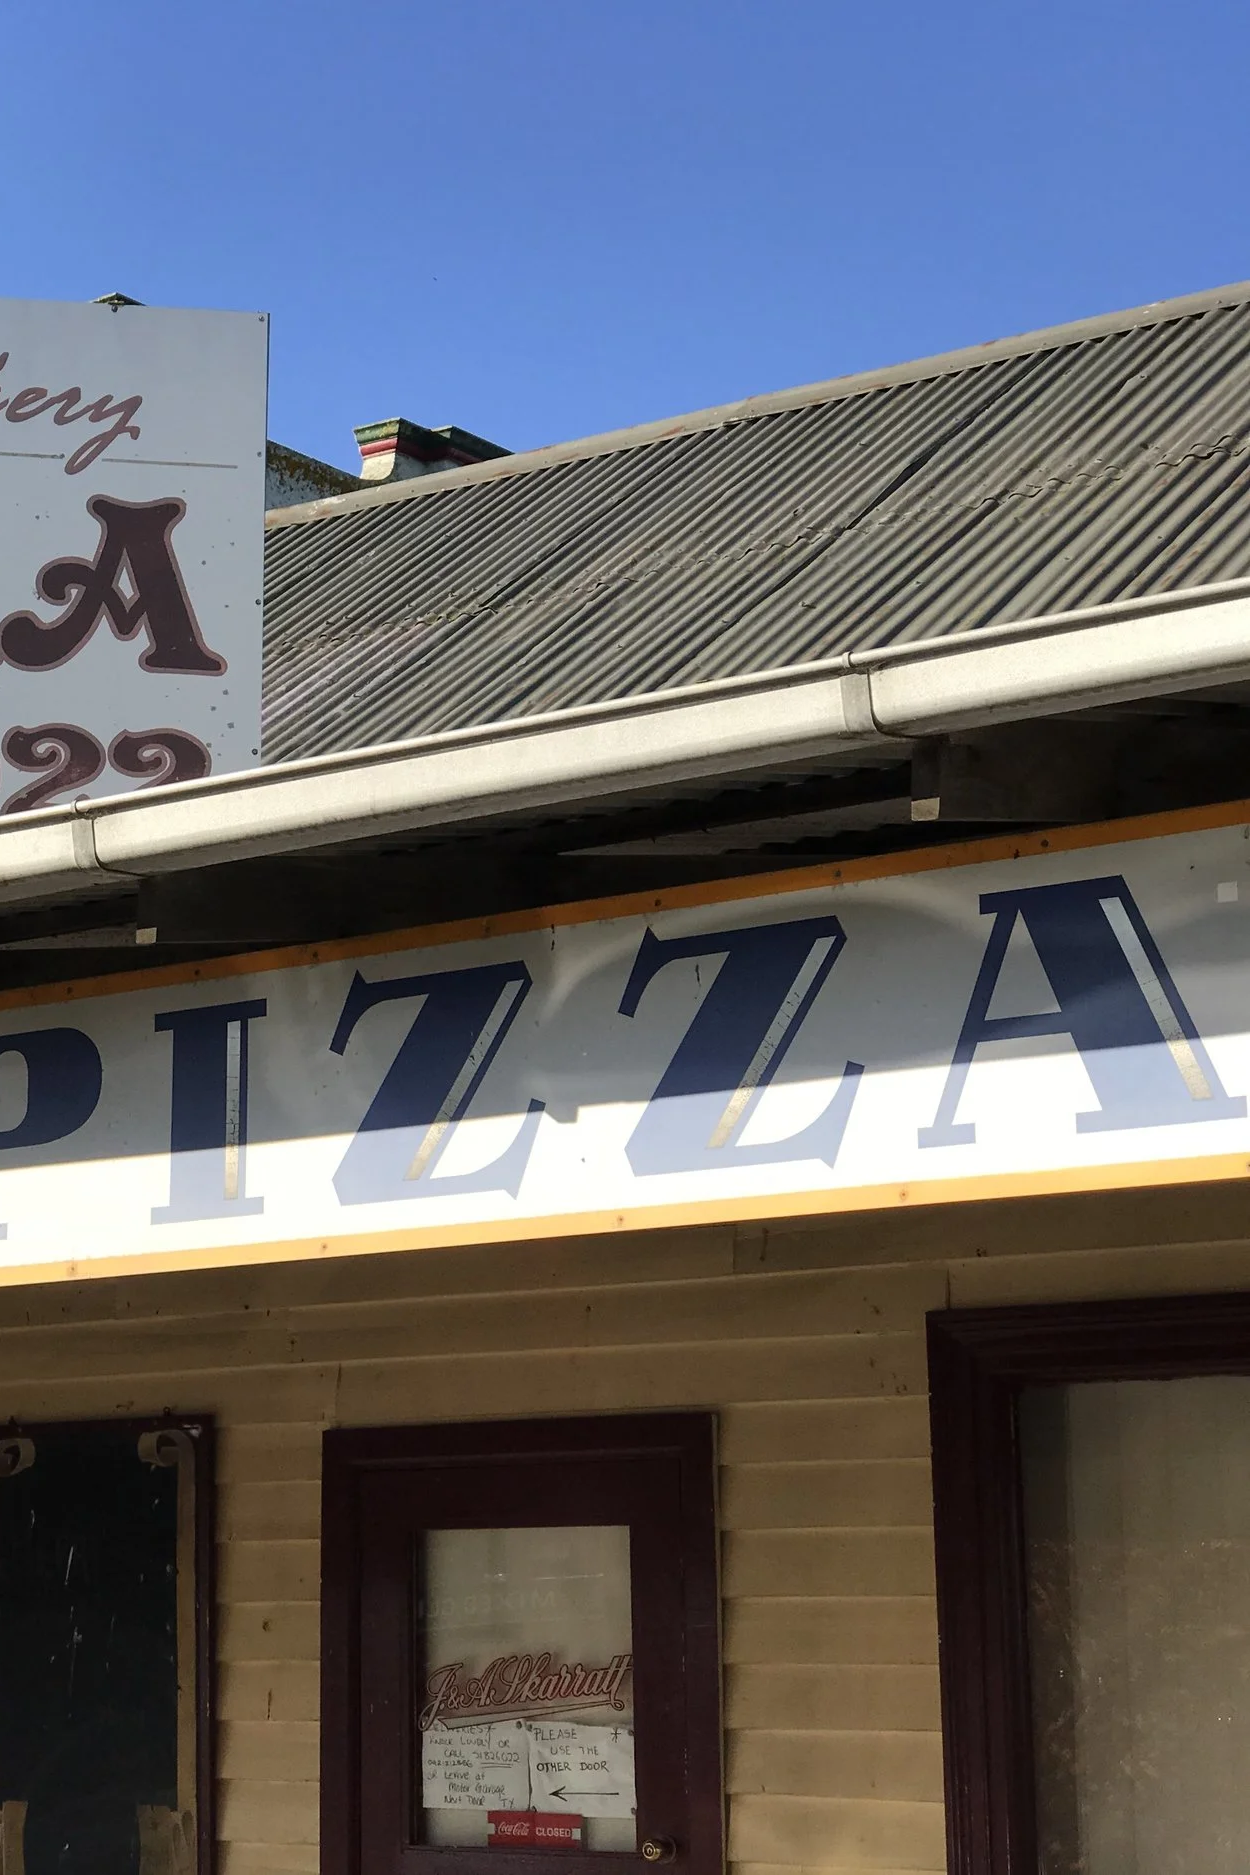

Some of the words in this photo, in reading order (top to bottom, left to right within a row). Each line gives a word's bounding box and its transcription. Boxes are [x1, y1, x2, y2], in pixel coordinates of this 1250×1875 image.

[533, 1727, 578, 1742] PLEASE
[550, 1745, 571, 1756] USE
[579, 1745, 599, 1756] THE
[536, 1761, 572, 1773] OTHER
[579, 1760, 610, 1773] DOOR
[535, 1826, 571, 1838] CLOSED
